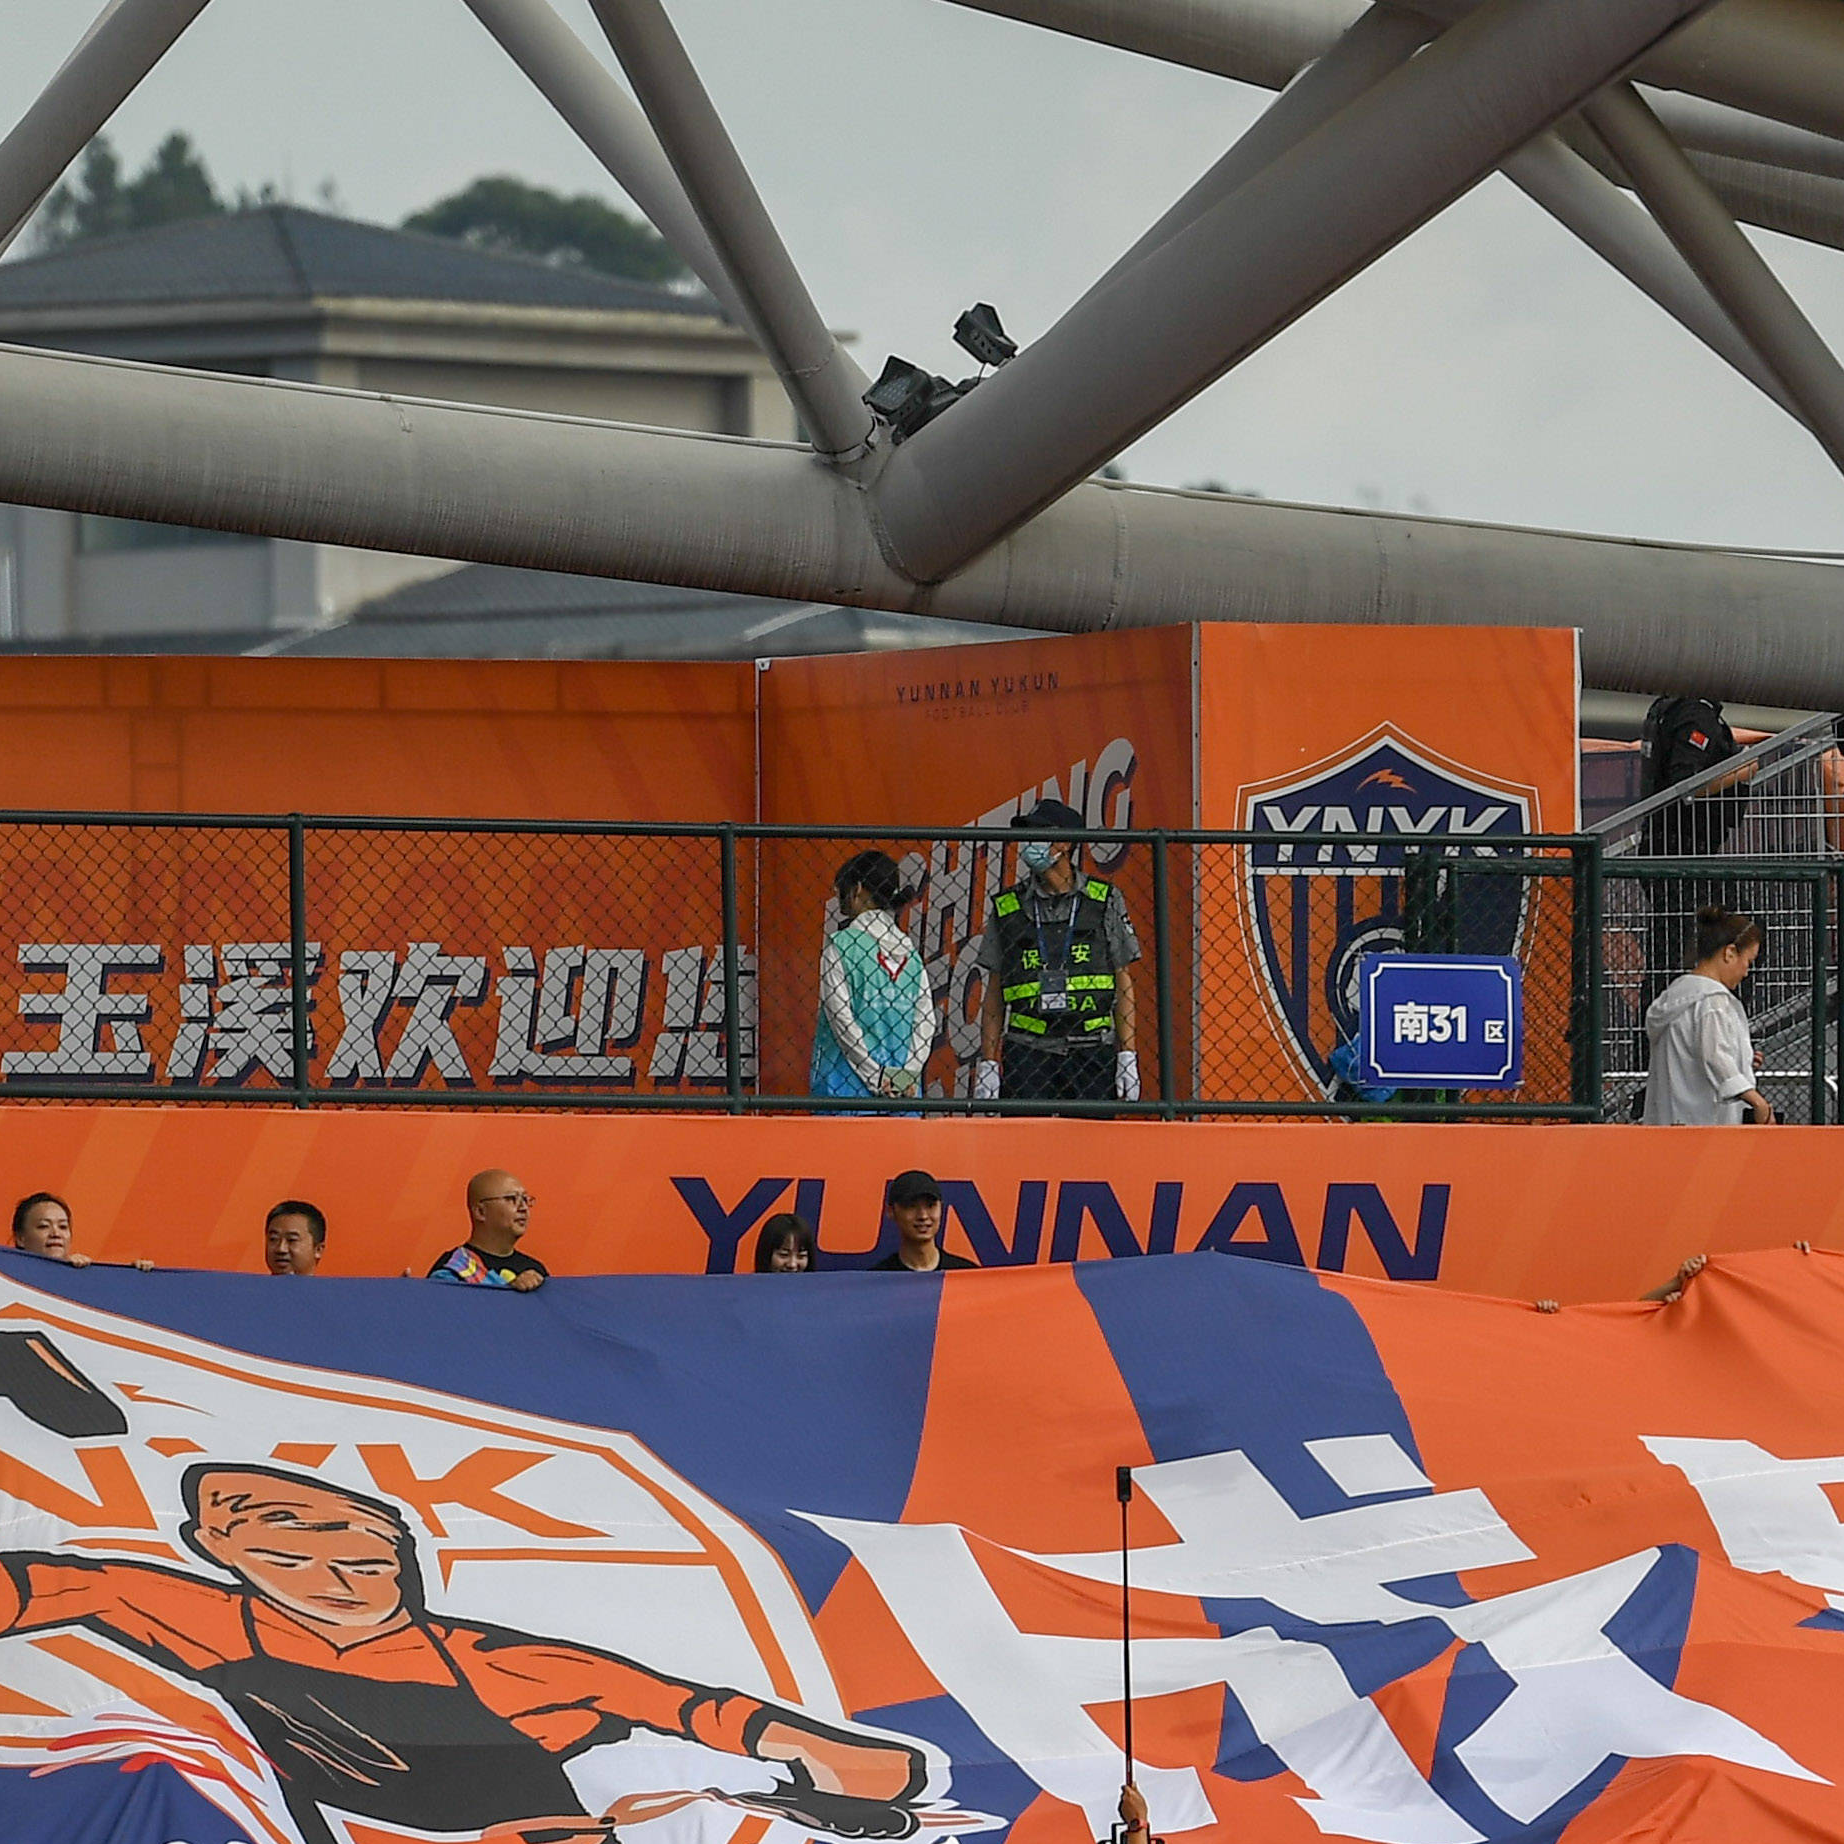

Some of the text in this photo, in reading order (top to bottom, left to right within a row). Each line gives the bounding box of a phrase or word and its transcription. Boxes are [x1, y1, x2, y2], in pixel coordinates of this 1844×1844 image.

[895, 671, 1059, 703] YUNNAN YUKUN
[1262, 805, 1509, 862] YNYK
[1021, 943, 1092, 970] 保安
[1393, 1001, 1506, 1044] 南31 区
